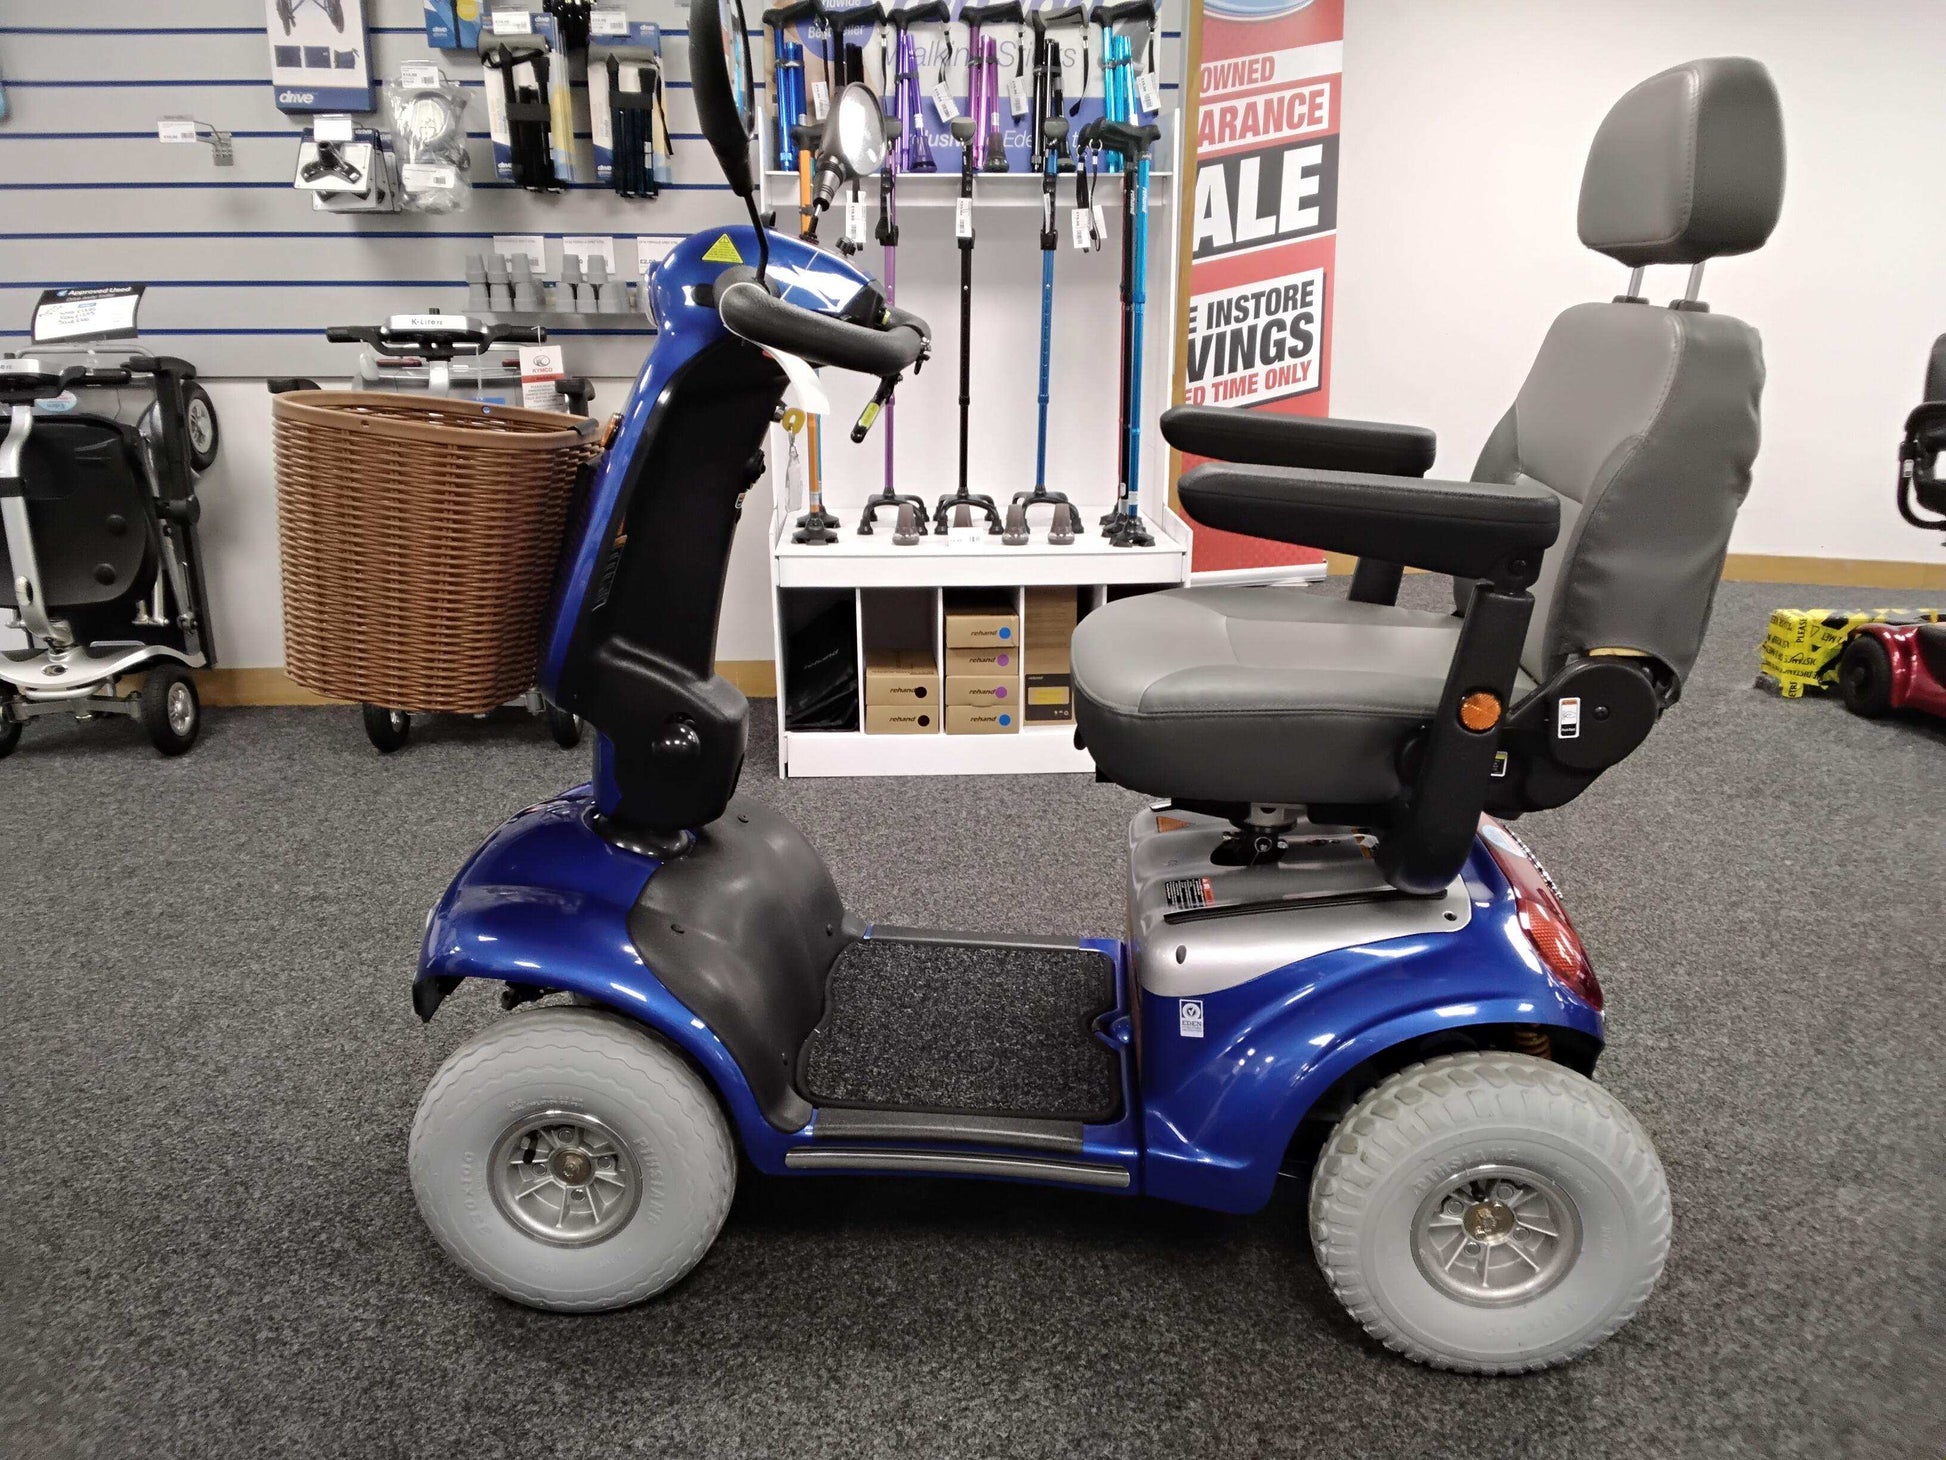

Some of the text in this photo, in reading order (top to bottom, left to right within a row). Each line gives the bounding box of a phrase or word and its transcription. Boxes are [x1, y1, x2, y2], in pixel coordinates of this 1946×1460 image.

[1200, 55, 1275, 93] OWNED
[279, 90, 314, 104] drive
[1198, 88, 1325, 148] ARANCE
[1193, 144, 1323, 253] ALE
[1206, 279, 1315, 331] INSTORE
[1187, 311, 1314, 383] VINGS
[1211, 372, 1259, 403] TIME
[1264, 359, 1312, 391] ONLY
[971, 629, 998, 637] rehand
[969, 656, 996, 664] rehand
[889, 715, 916, 723] rehand
[970, 715, 997, 723] rehand
